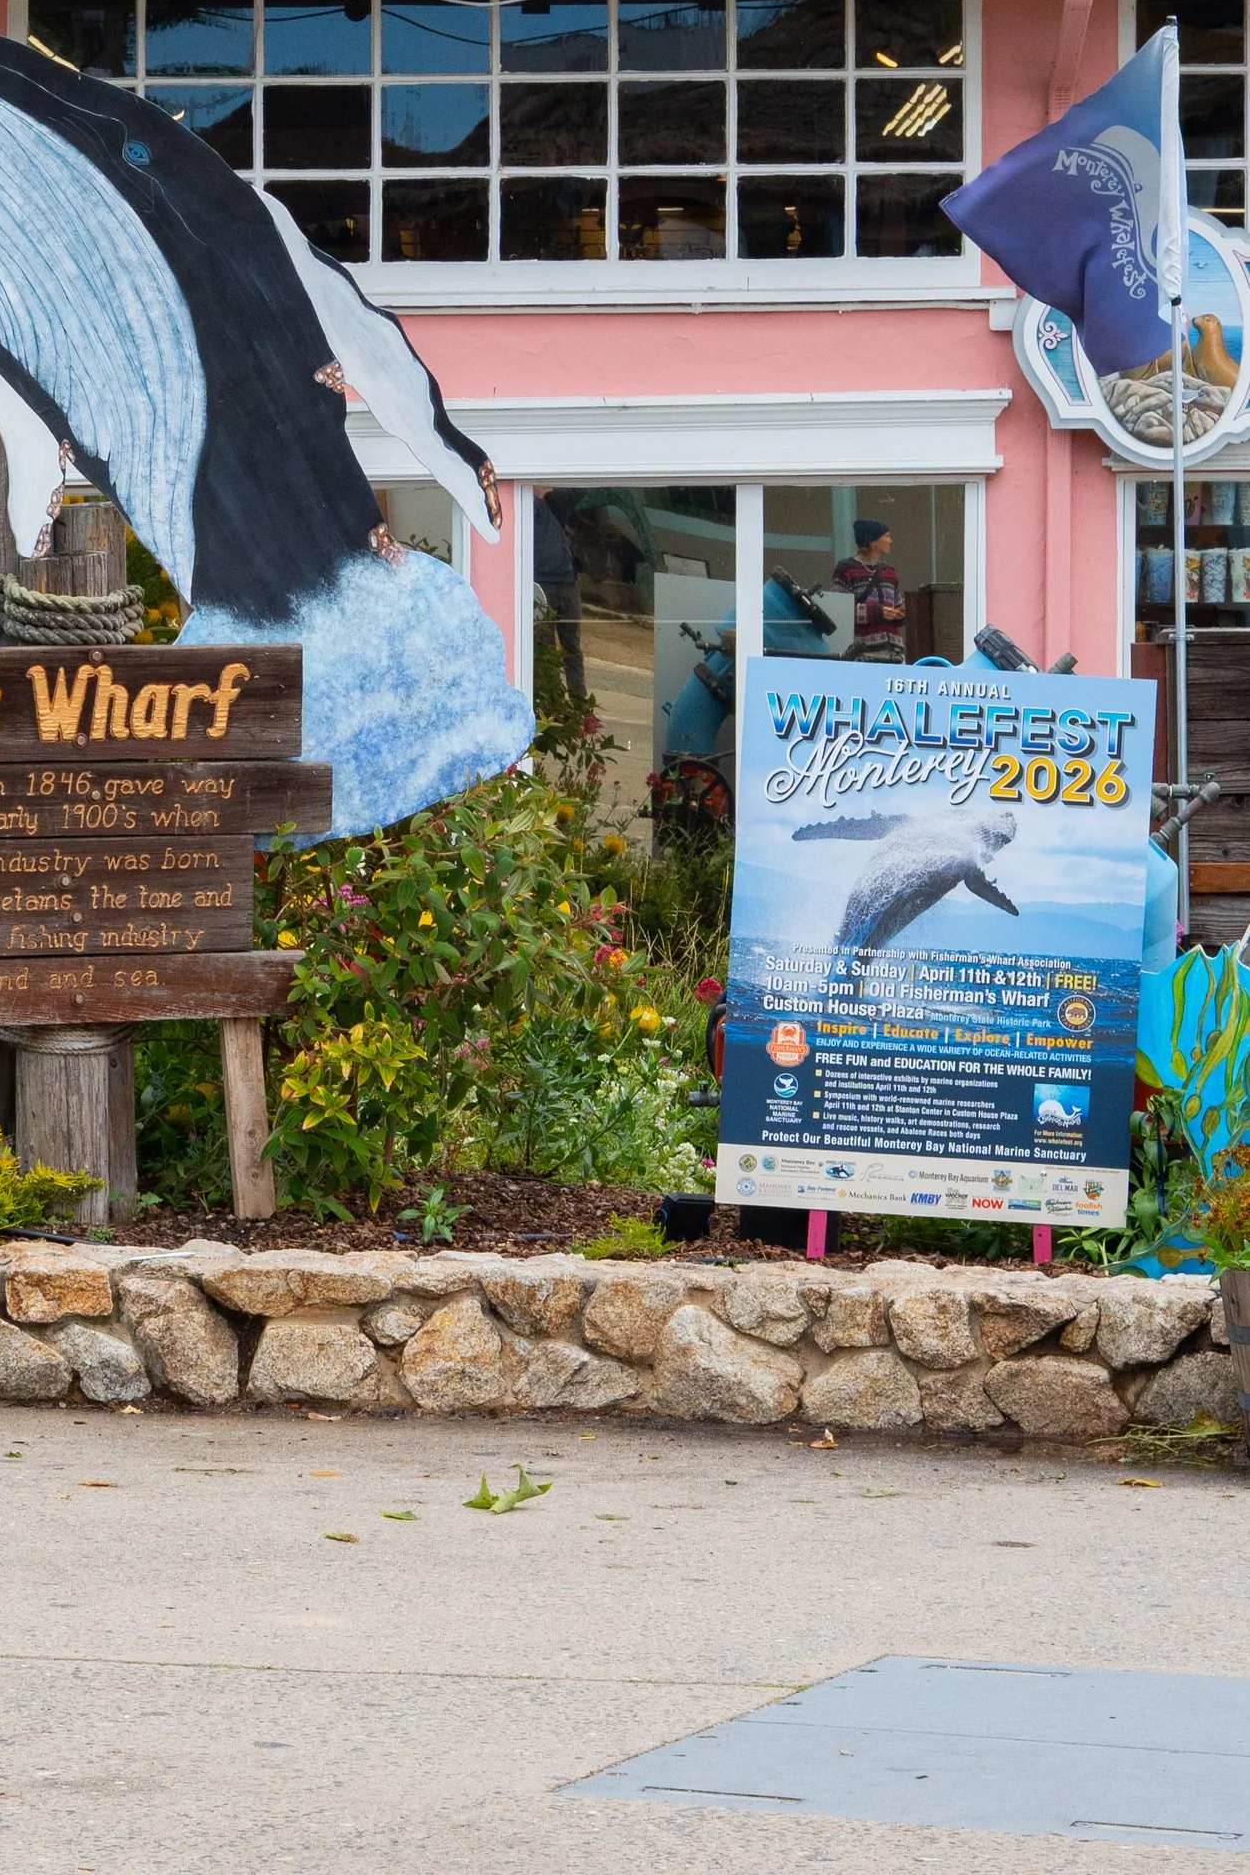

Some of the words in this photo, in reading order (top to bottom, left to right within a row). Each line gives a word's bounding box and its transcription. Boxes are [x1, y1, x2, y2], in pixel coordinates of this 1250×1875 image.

[1052, 150, 1125, 198] Monterey
[1109, 199, 1146, 299] Whalefest
[885, 678, 928, 694] 16TH
[938, 684, 1010, 699] ANNUAL
[26, 663, 250, 743] Wharf
[765, 690, 1135, 757] WHALEFEST
[764, 730, 990, 807] Monterey
[989, 754, 1130, 807] 2026
[104, 779, 164, 801] gave
[181, 778, 235, 799] way
[62, 804, 137, 829] 1900's
[150, 804, 221, 828] when
[103, 853, 151, 871] was
[160, 847, 227, 870] born.
[91, 884, 127, 909] the
[139, 884, 182, 908] tone
[193, 883, 233, 908] and
[99, 923, 205, 950] industry
[794, 943, 838, 955] Presented
[841, 947, 849, 955] in
[853, 947, 906, 960] Partnership
[909, 951, 928, 960] with
[931, 951, 986, 964] Fisherman's
[989, 955, 1015, 966] Wharf
[1018, 957, 1071, 969] Association
[49, 965, 94, 989] and
[114, 968, 167, 987] sea.
[766, 955, 832, 976] Saturday
[836, 961, 847, 975] &
[851, 961, 906, 981] Sunday
[919, 965, 954, 983] April
[959, 968, 990, 984] 11th
[1055, 974, 1097, 990] FREE!
[869, 982, 894, 997] Old
[901, 984, 996, 1004] Fisherman's
[1001, 990, 1050, 1007] Wharf
[763, 995, 823, 1013] Custom
[828, 999, 876, 1017] House
[881, 1002, 924, 1020] Plaza
[930, 1012, 969, 1024] Monterey
[972, 1015, 994, 1024] State
[997, 1017, 1030, 1026] Historic
[1032, 1018, 1051, 1028] Park
[817, 1020, 867, 1037] Inspire
[883, 1023, 939, 1039] Educate
[954, 1028, 1010, 1045] Explore
[1026, 1034, 1093, 1050] Empower
[816, 1038, 841, 1048] ENJOY
[843, 1039, 859, 1048] AND
[861, 1041, 908, 1052] EXPERIENCE
[909, 1043, 916, 1052] A
[917, 1043, 937, 1053] WIDE
[938, 1045, 971, 1056] VARIETY
[973, 1047, 983, 1056] OF
[985, 1048, 1048, 1060] OCEAN-RELATED
[1050, 1052, 1092, 1063] ACTIVITIES
[815, 1052, 843, 1065] FREE
[845, 1054, 868, 1067] FUN
[870, 1056, 891, 1068] and
[894, 1057, 956, 1073] EDUCATION
[958, 1061, 981, 1074] FOR
[983, 1063, 1004, 1075] THE
[1006, 1065, 1046, 1078] WHOLE
[1048, 1067, 1092, 1081] FAMILY!
[825, 1069, 849, 1079] Dozens
[850, 1071, 857, 1079] of
[858, 1071, 892, 1082] interactive
[893, 1073, 920, 1083] exhibits
[921, 1075, 928, 1085] by
[930, 1077, 953, 1086] marine
[954, 1078, 998, 1089] organizations
[824, 1091, 861, 1102] Symposium
[865, 1093, 877, 1101] with
[879, 1094, 931, 1105] world-renowned
[933, 1097, 955, 1106] marine
[957, 1099, 995, 1109] researchers
[765, 1116, 802, 1124] SANCTUARY
[762, 1130, 799, 1142] Protect
[803, 1133, 821, 1144] Our
[824, 1134, 871, 1147] Beautiful
[874, 1138, 922, 1152] Monterey
[926, 1141, 944, 1153] Bay
[949, 1142, 991, 1155] National
[995, 1145, 1031, 1157] Marine
[1034, 1148, 1086, 1163] Sanctuary
[919, 1172, 946, 1182] Monterey
[948, 1173, 959, 1183] Bay
[960, 1174, 988, 1183] Aquarium
[1052, 1184, 1064, 1192] DEL
[1065, 1185, 1078, 1193] MAR
[849, 1191, 887, 1200] Mechanics
[911, 1193, 942, 1205] KMBY
[972, 1198, 1004, 1209] NOW
[1076, 1202, 1102, 1210] foolish
